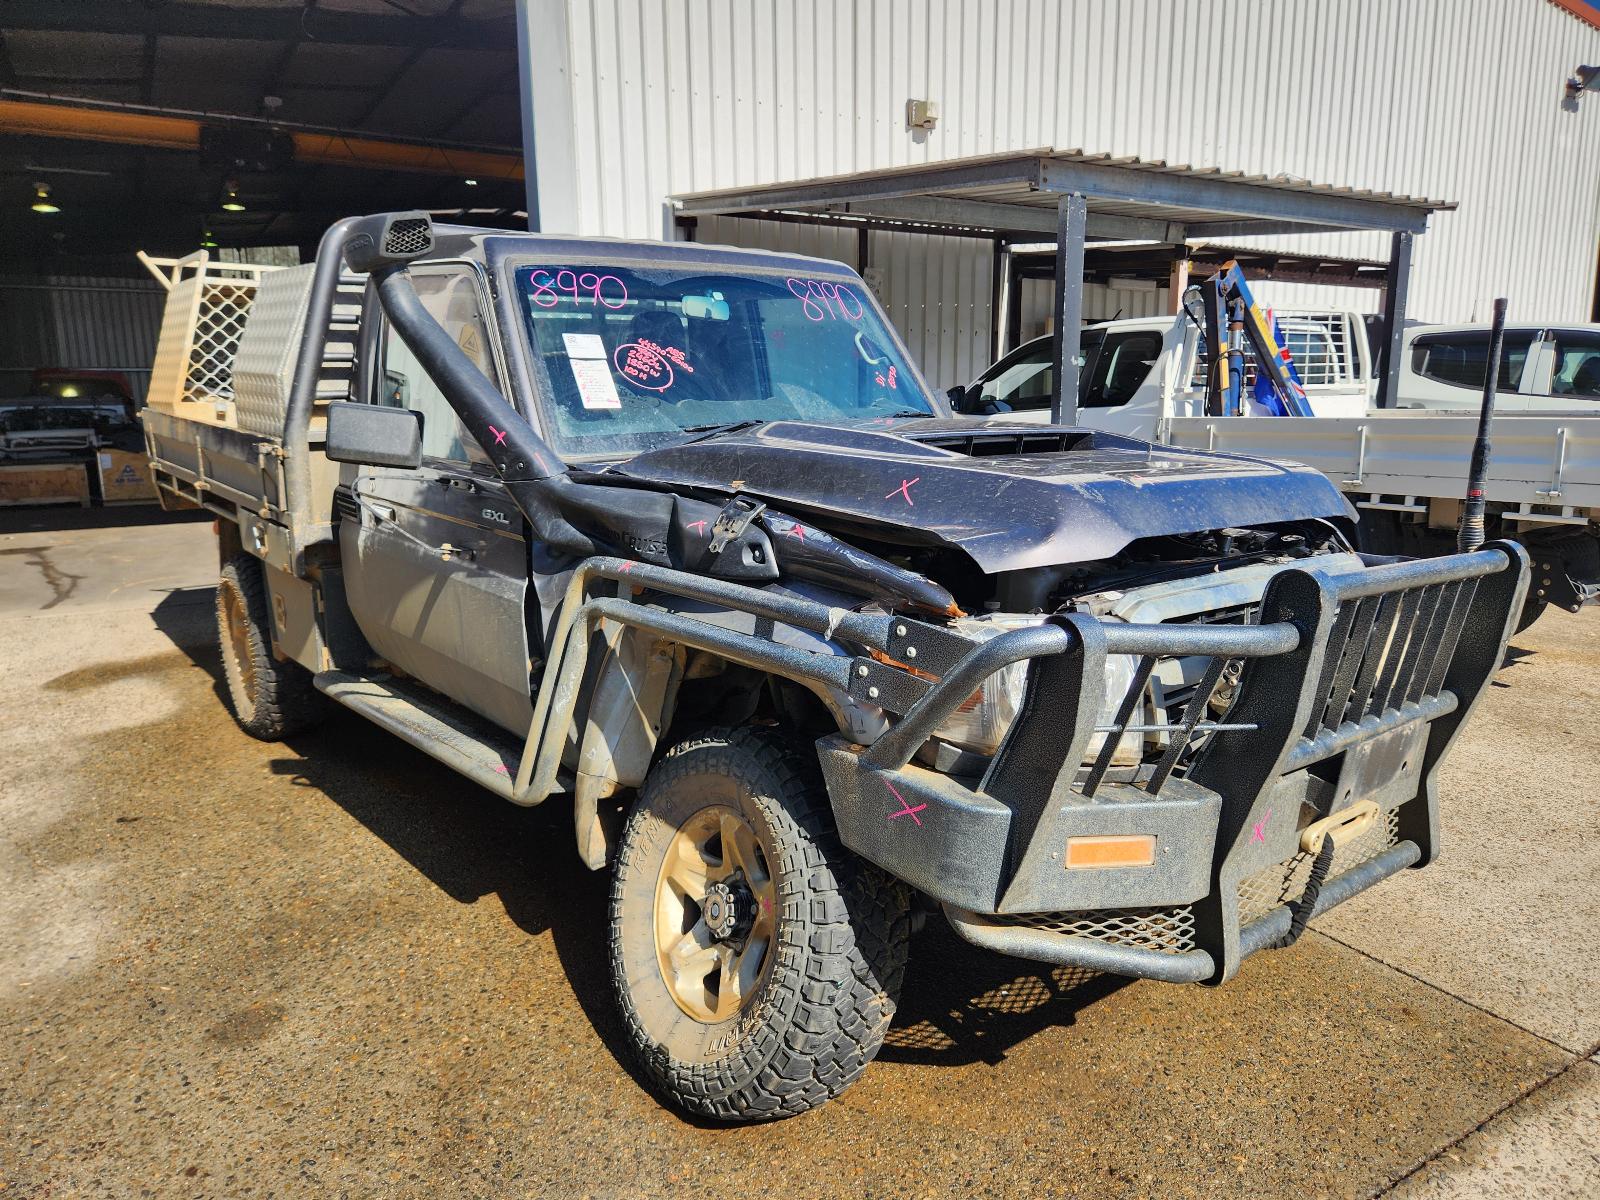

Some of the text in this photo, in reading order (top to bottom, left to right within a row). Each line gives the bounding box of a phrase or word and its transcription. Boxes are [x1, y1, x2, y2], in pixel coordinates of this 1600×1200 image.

[530, 269, 628, 309] 8990
[786, 278, 863, 321] 8990
[481, 508, 510, 525] GXL
